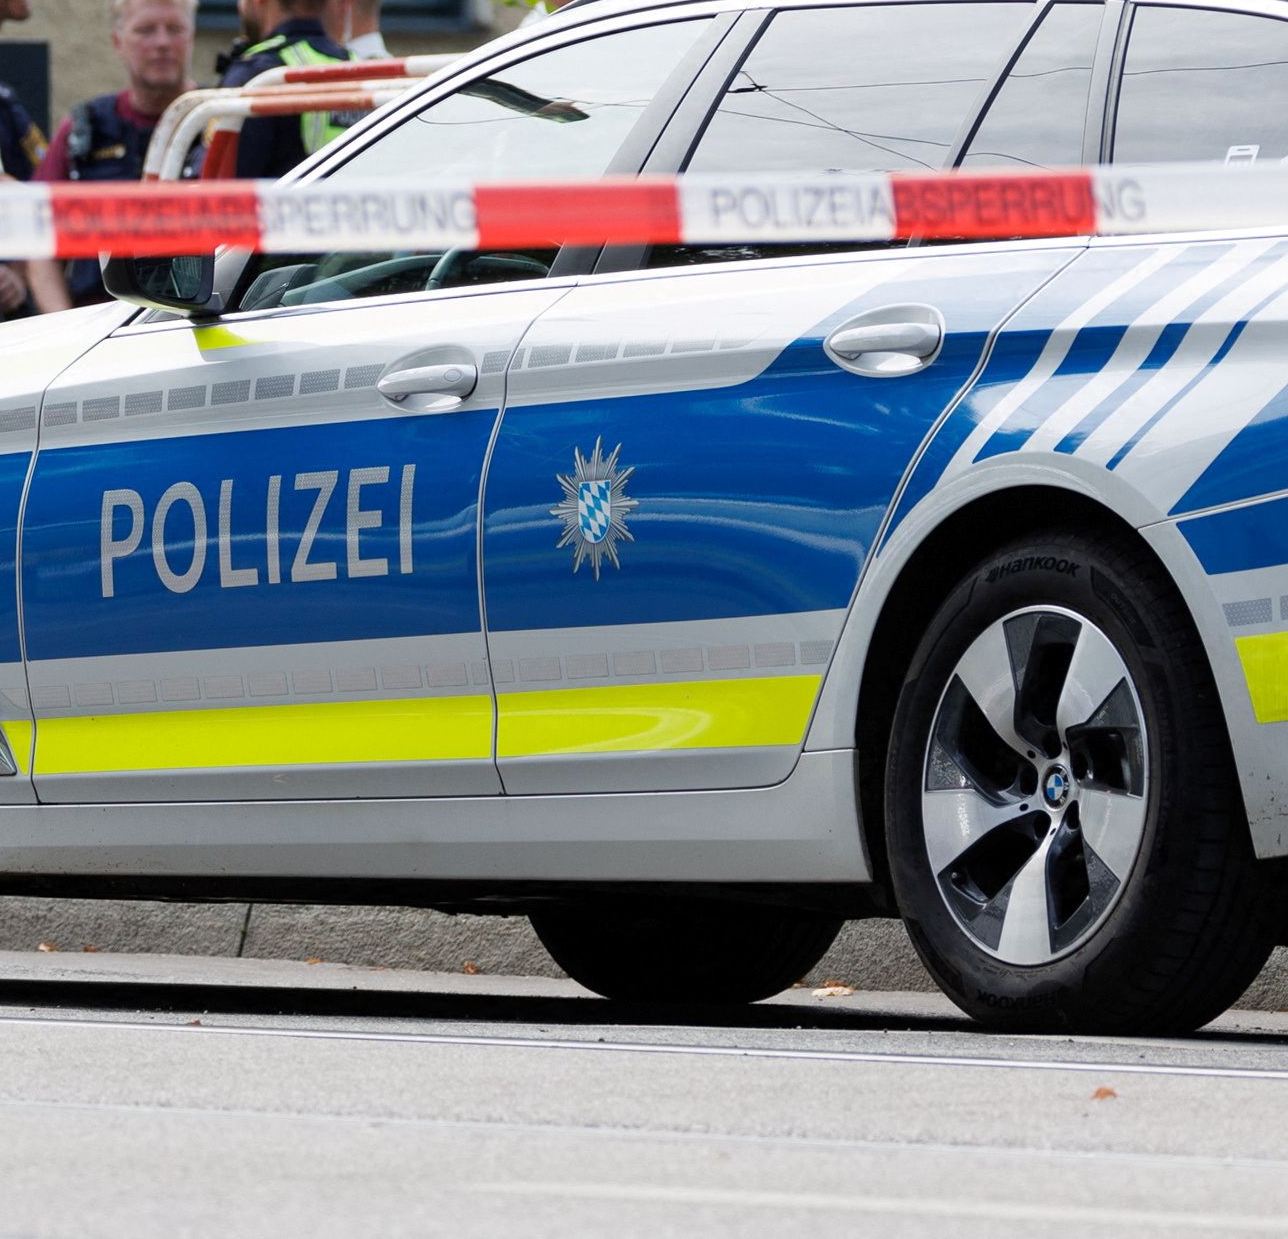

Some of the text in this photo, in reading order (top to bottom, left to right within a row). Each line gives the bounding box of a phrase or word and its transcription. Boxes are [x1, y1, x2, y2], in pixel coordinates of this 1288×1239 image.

[35, 191, 477, 243] POLIZEIABSPERRUNG
[711, 178, 1147, 229] POLIZEIABSPERRUNG
[100, 463, 417, 598] POLIZEI
